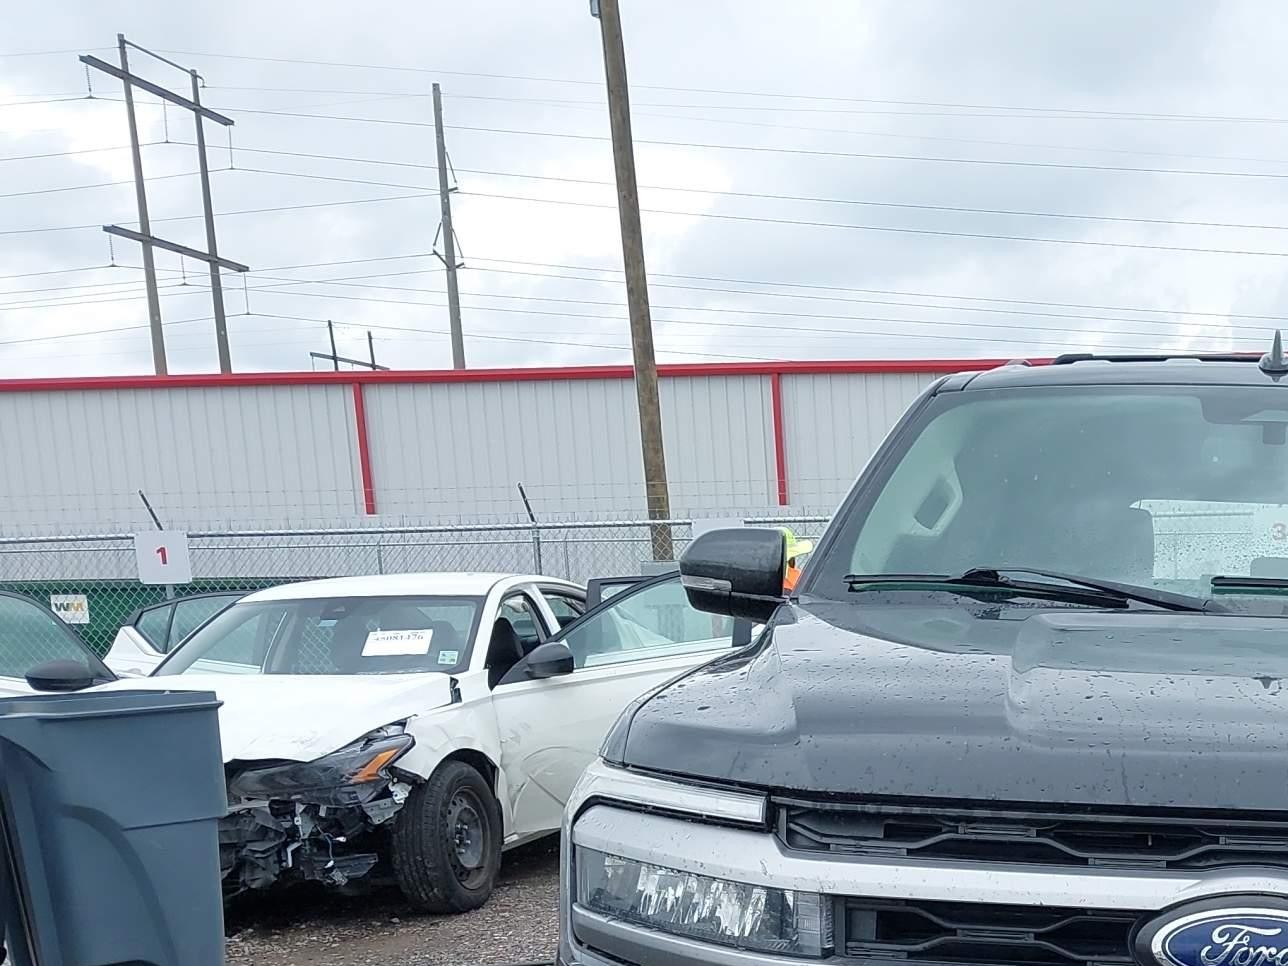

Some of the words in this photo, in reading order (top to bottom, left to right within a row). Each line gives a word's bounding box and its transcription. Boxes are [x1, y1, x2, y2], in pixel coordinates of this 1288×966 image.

[1271, 522, 1288, 541] 3
[155, 546, 168, 565] 1
[54, 602, 85, 612] WM
